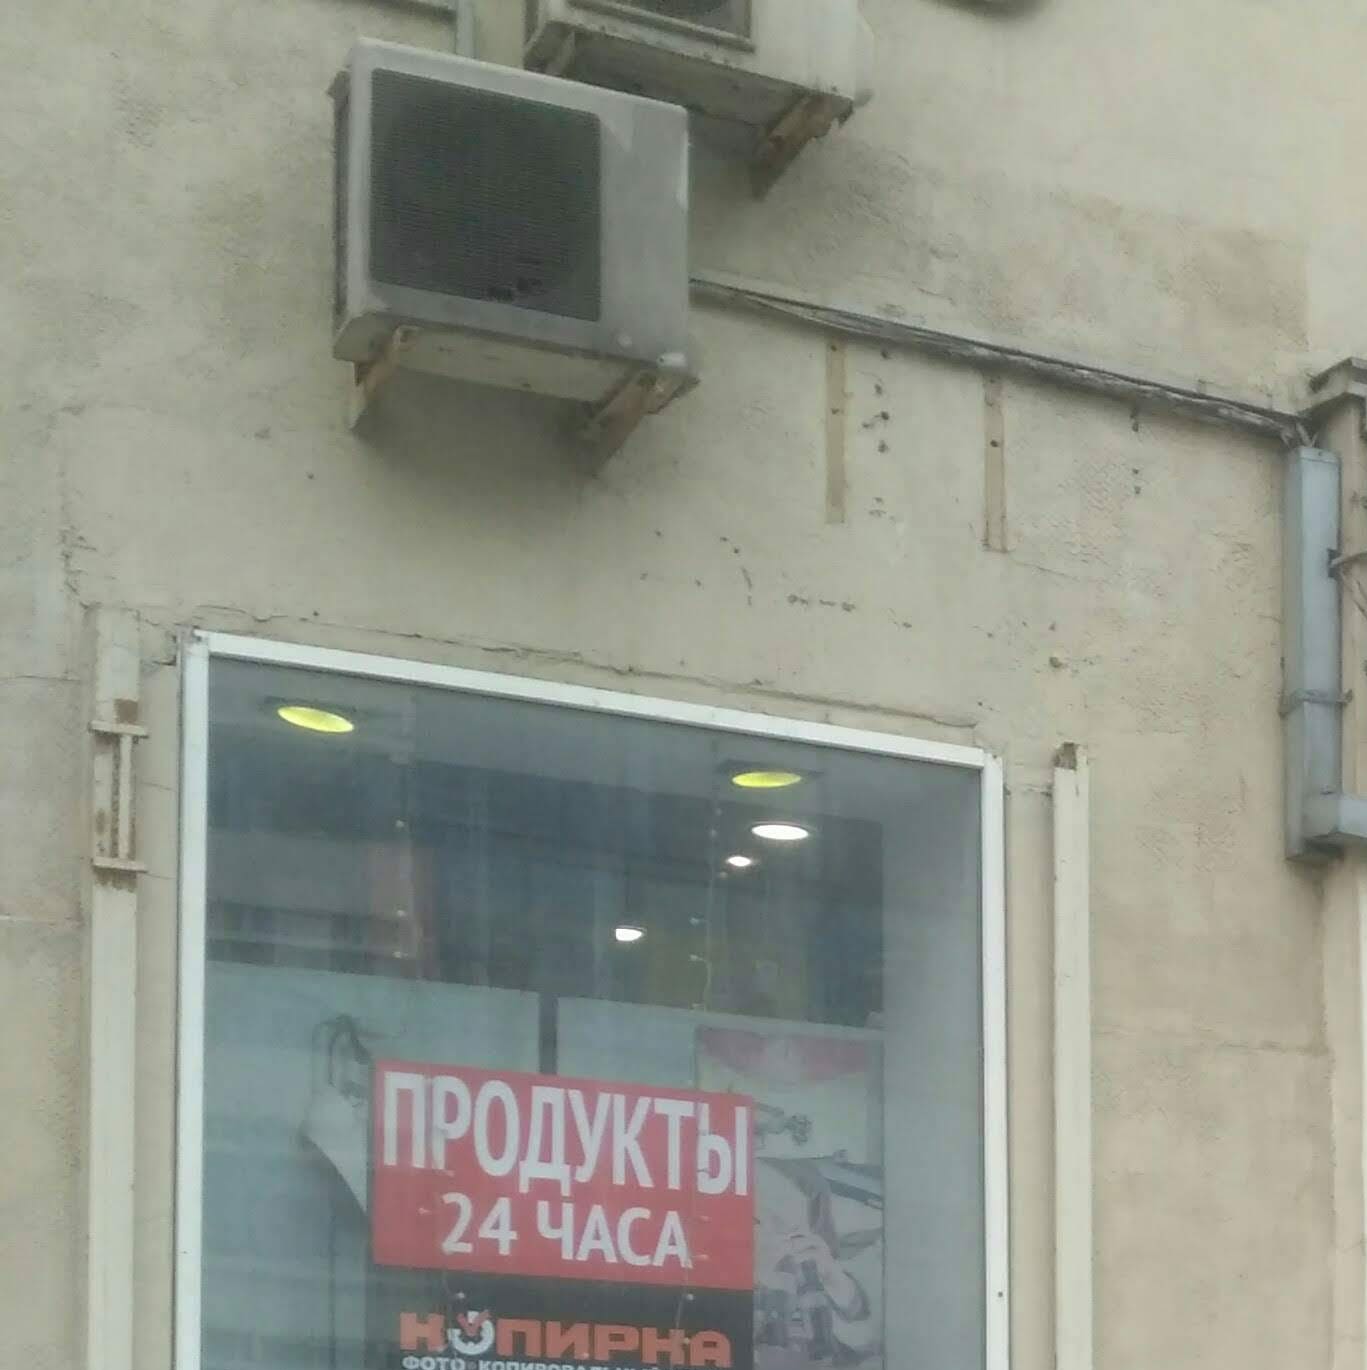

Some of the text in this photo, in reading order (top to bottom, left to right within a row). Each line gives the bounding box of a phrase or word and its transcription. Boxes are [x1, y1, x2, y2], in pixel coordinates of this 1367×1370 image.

[383, 1070, 749, 1197] ПРОДУКТЫ
[441, 1192, 693, 1268] 24 ЧАСА
